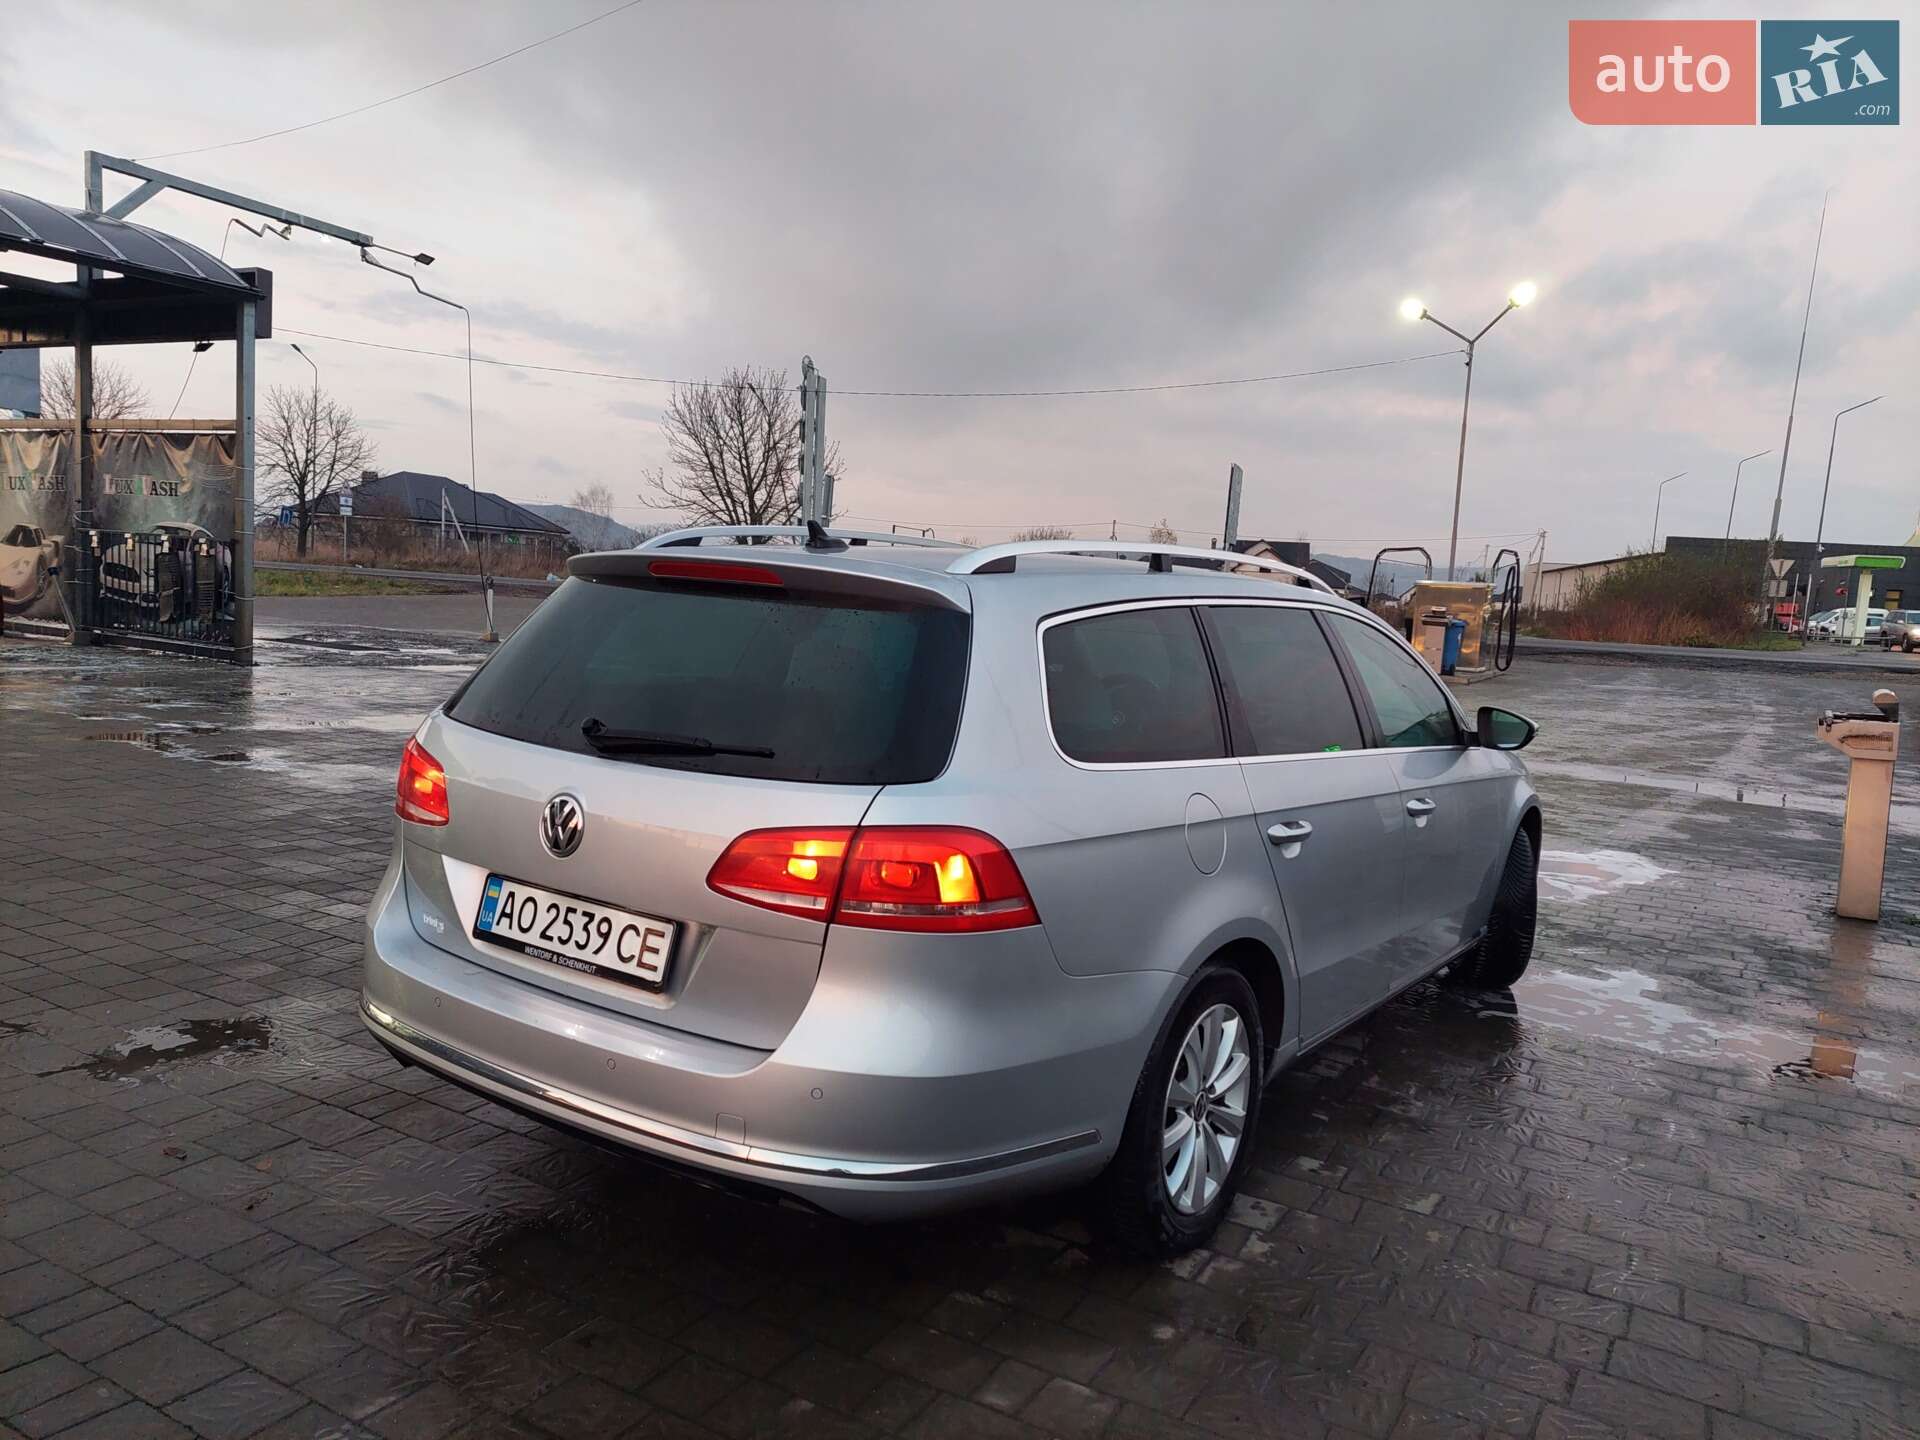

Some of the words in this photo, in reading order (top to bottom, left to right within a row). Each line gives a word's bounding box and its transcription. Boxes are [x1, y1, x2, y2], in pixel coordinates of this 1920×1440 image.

[481, 910, 494, 924] UA
[496, 891, 538, 934] AO
[539, 902, 613, 956] 2539
[616, 923, 666, 972] CE
[524, 945, 553, 961] WENTORF
